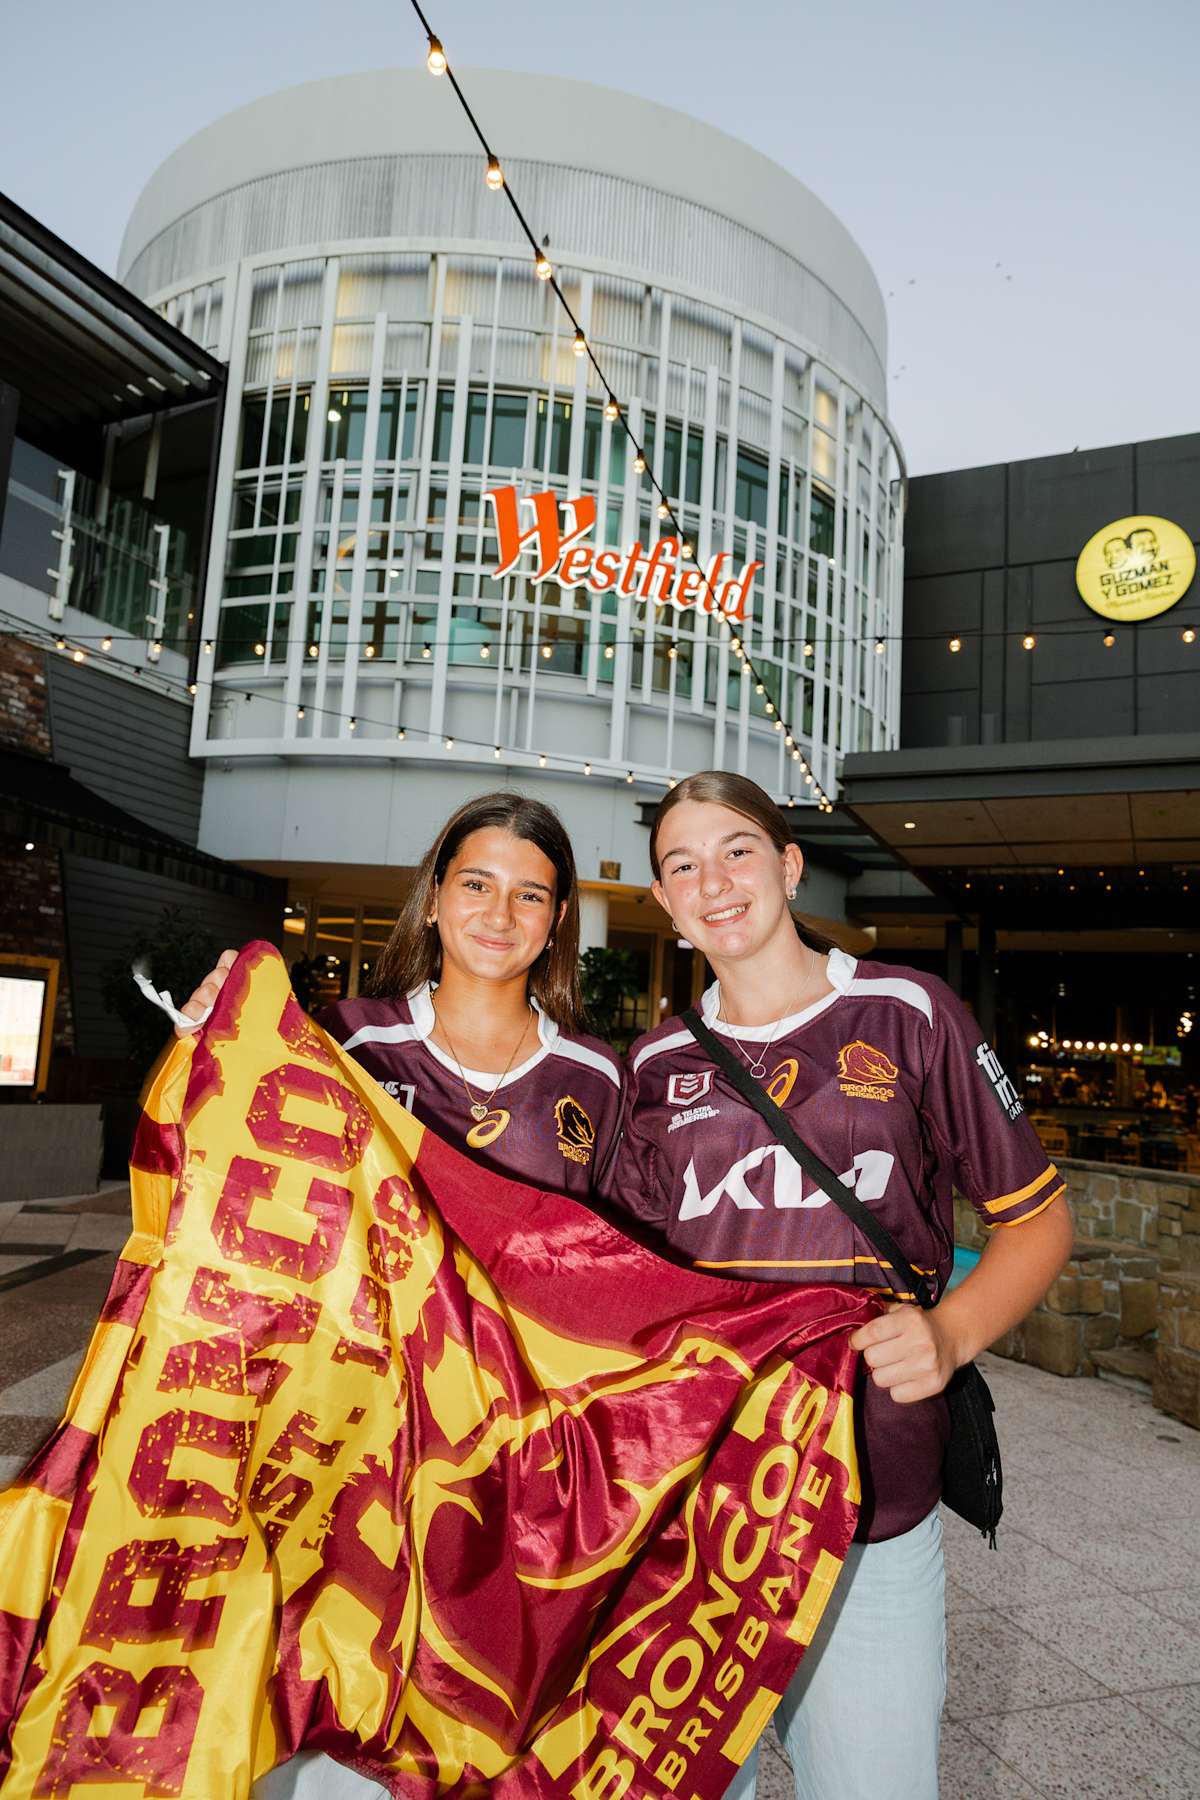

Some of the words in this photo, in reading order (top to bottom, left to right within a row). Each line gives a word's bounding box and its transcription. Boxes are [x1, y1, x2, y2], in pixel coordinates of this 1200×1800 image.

[481, 484, 766, 625] Westfield
[1100, 558, 1169, 587] GUZMAN
[1102, 588, 1112, 600] Y
[1116, 573, 1174, 597] GOMEZ
[839, 1083, 895, 1098] BRONCOS
[330, 1174, 432, 1377] 1988
[568, 1379, 828, 1800] BRONCOS
[654, 1463, 833, 1792] BRISBANE
